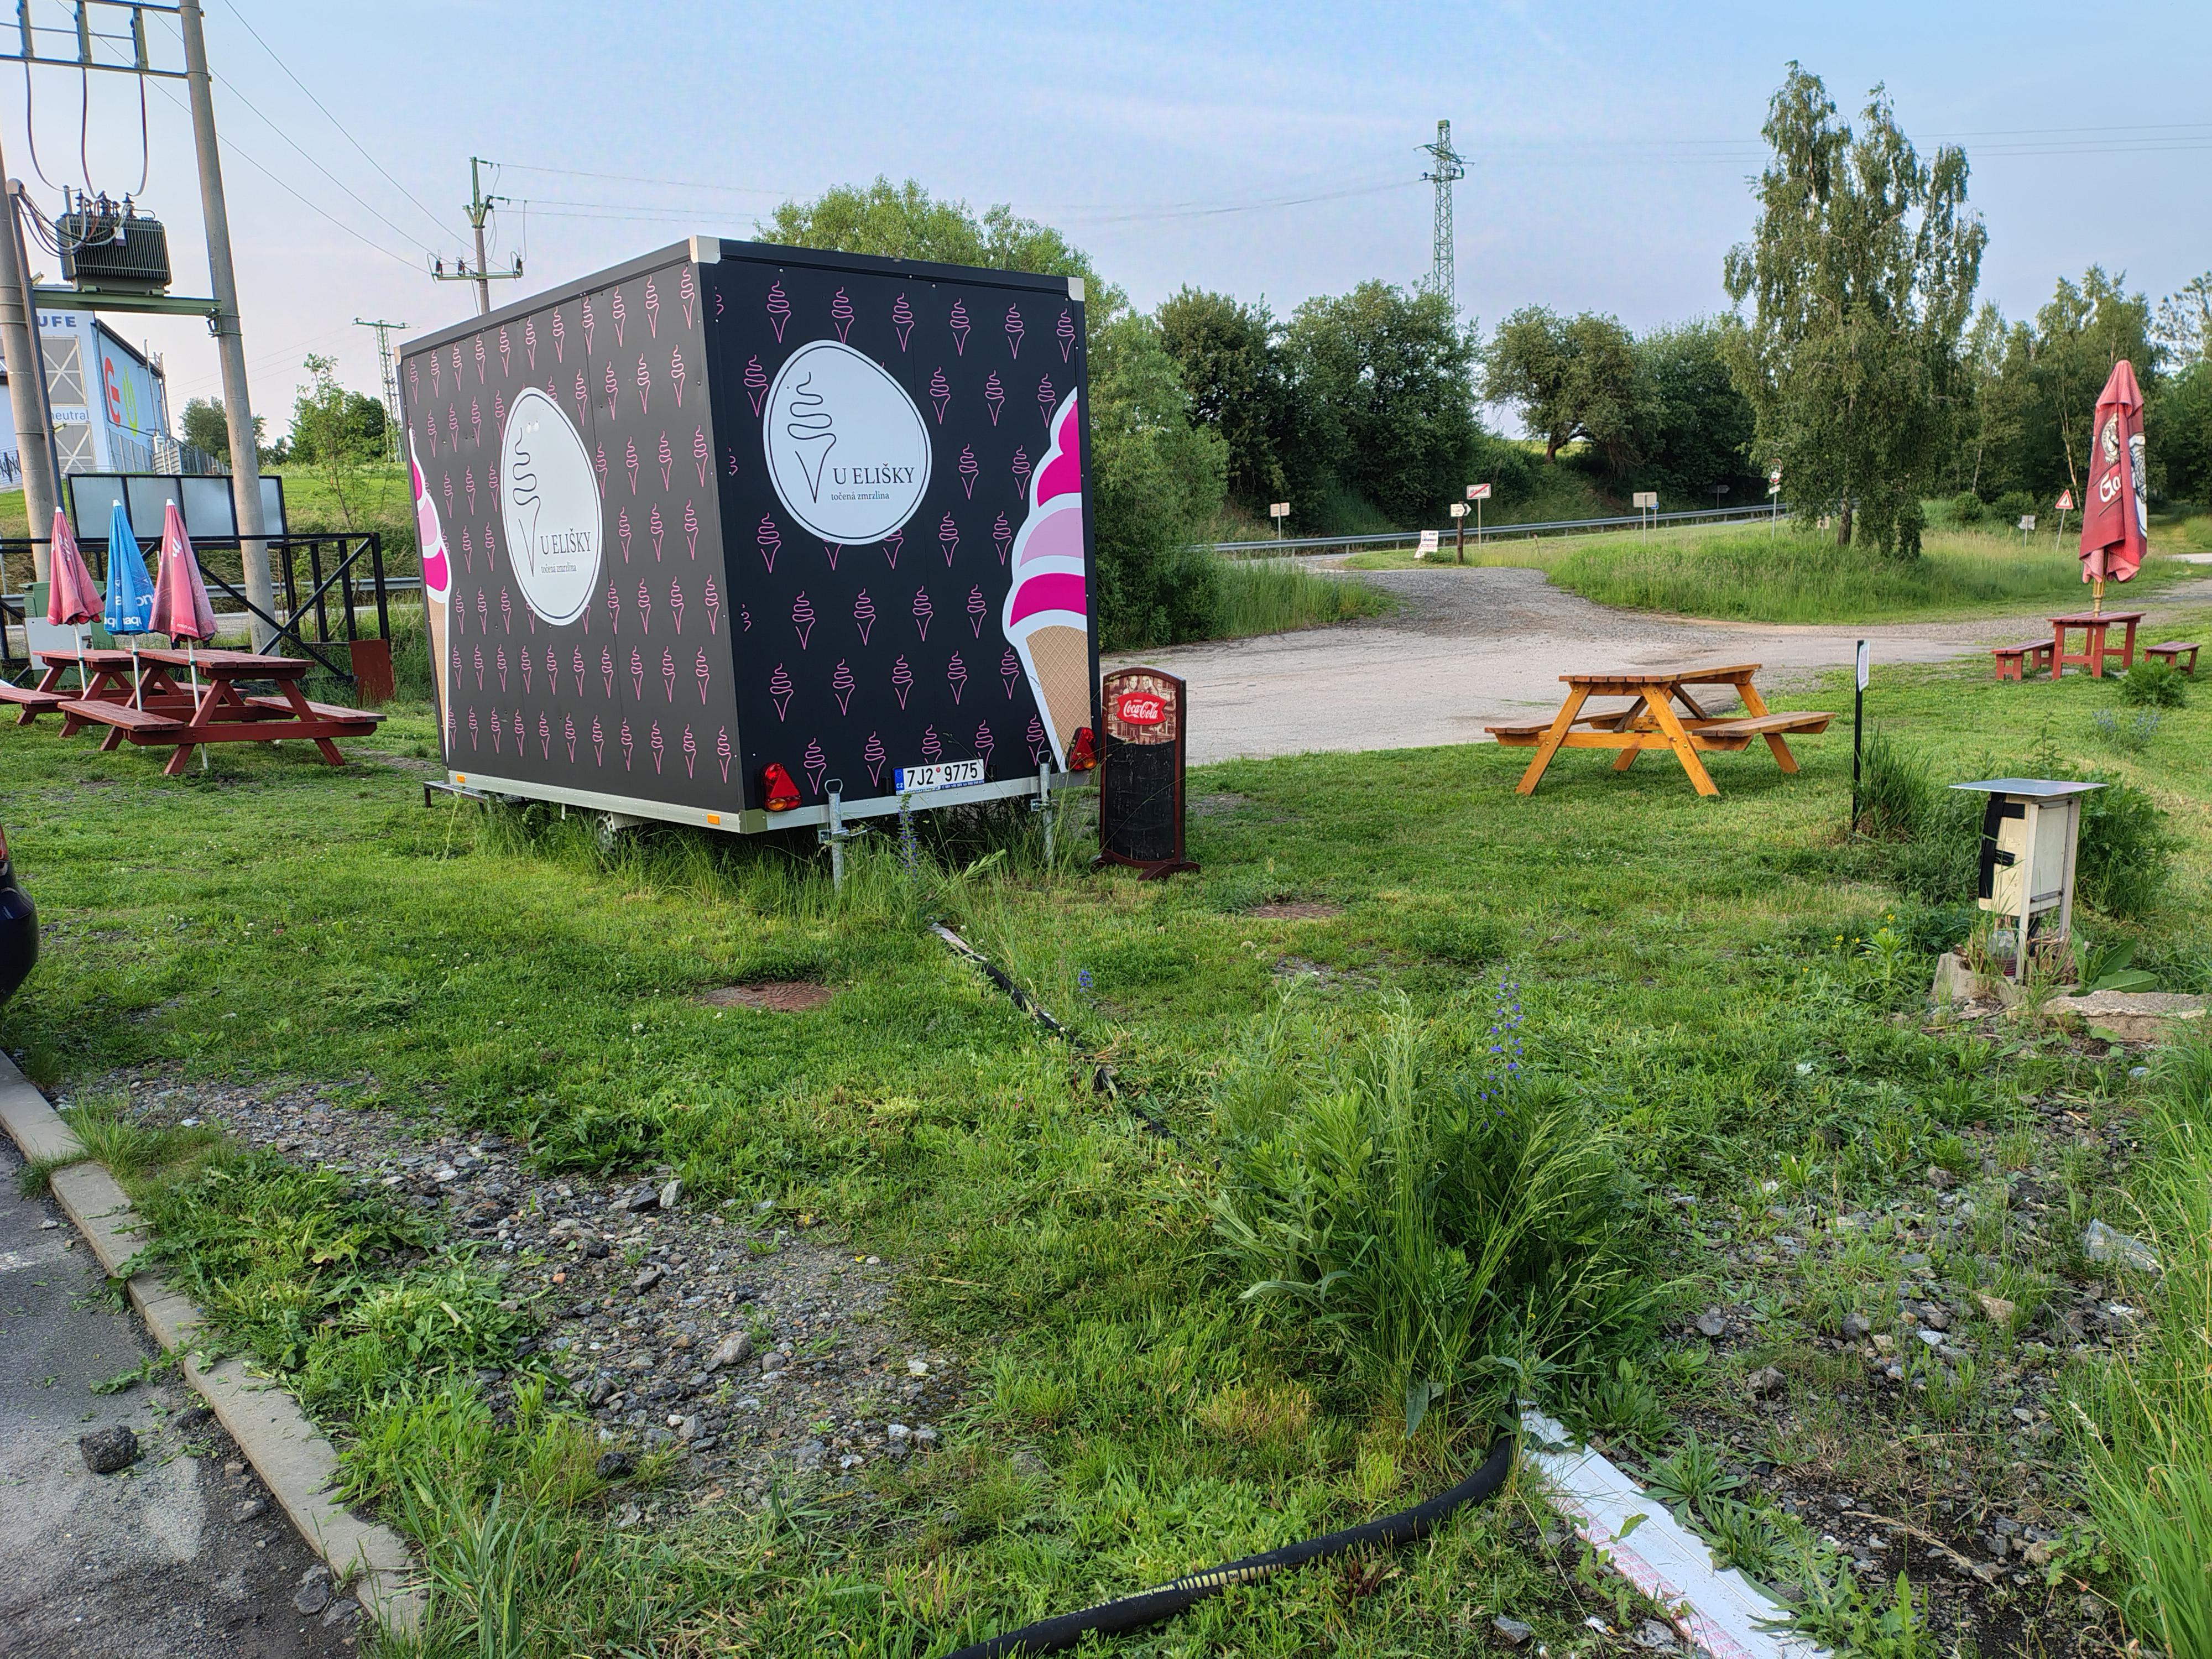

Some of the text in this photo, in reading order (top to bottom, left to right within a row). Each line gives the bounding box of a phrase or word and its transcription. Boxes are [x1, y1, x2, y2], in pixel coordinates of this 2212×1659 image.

[832, 463, 915, 485] U ELIŠKY
[831, 490, 890, 500] točená zmrzlina
[540, 528, 591, 555] U ELIŠKY
[541, 561, 577, 573] točená zmrzlina
[1123, 700, 1159, 719] Coca-Cola
[907, 768, 934, 787] 7J2
[944, 762, 978, 782] 9775
